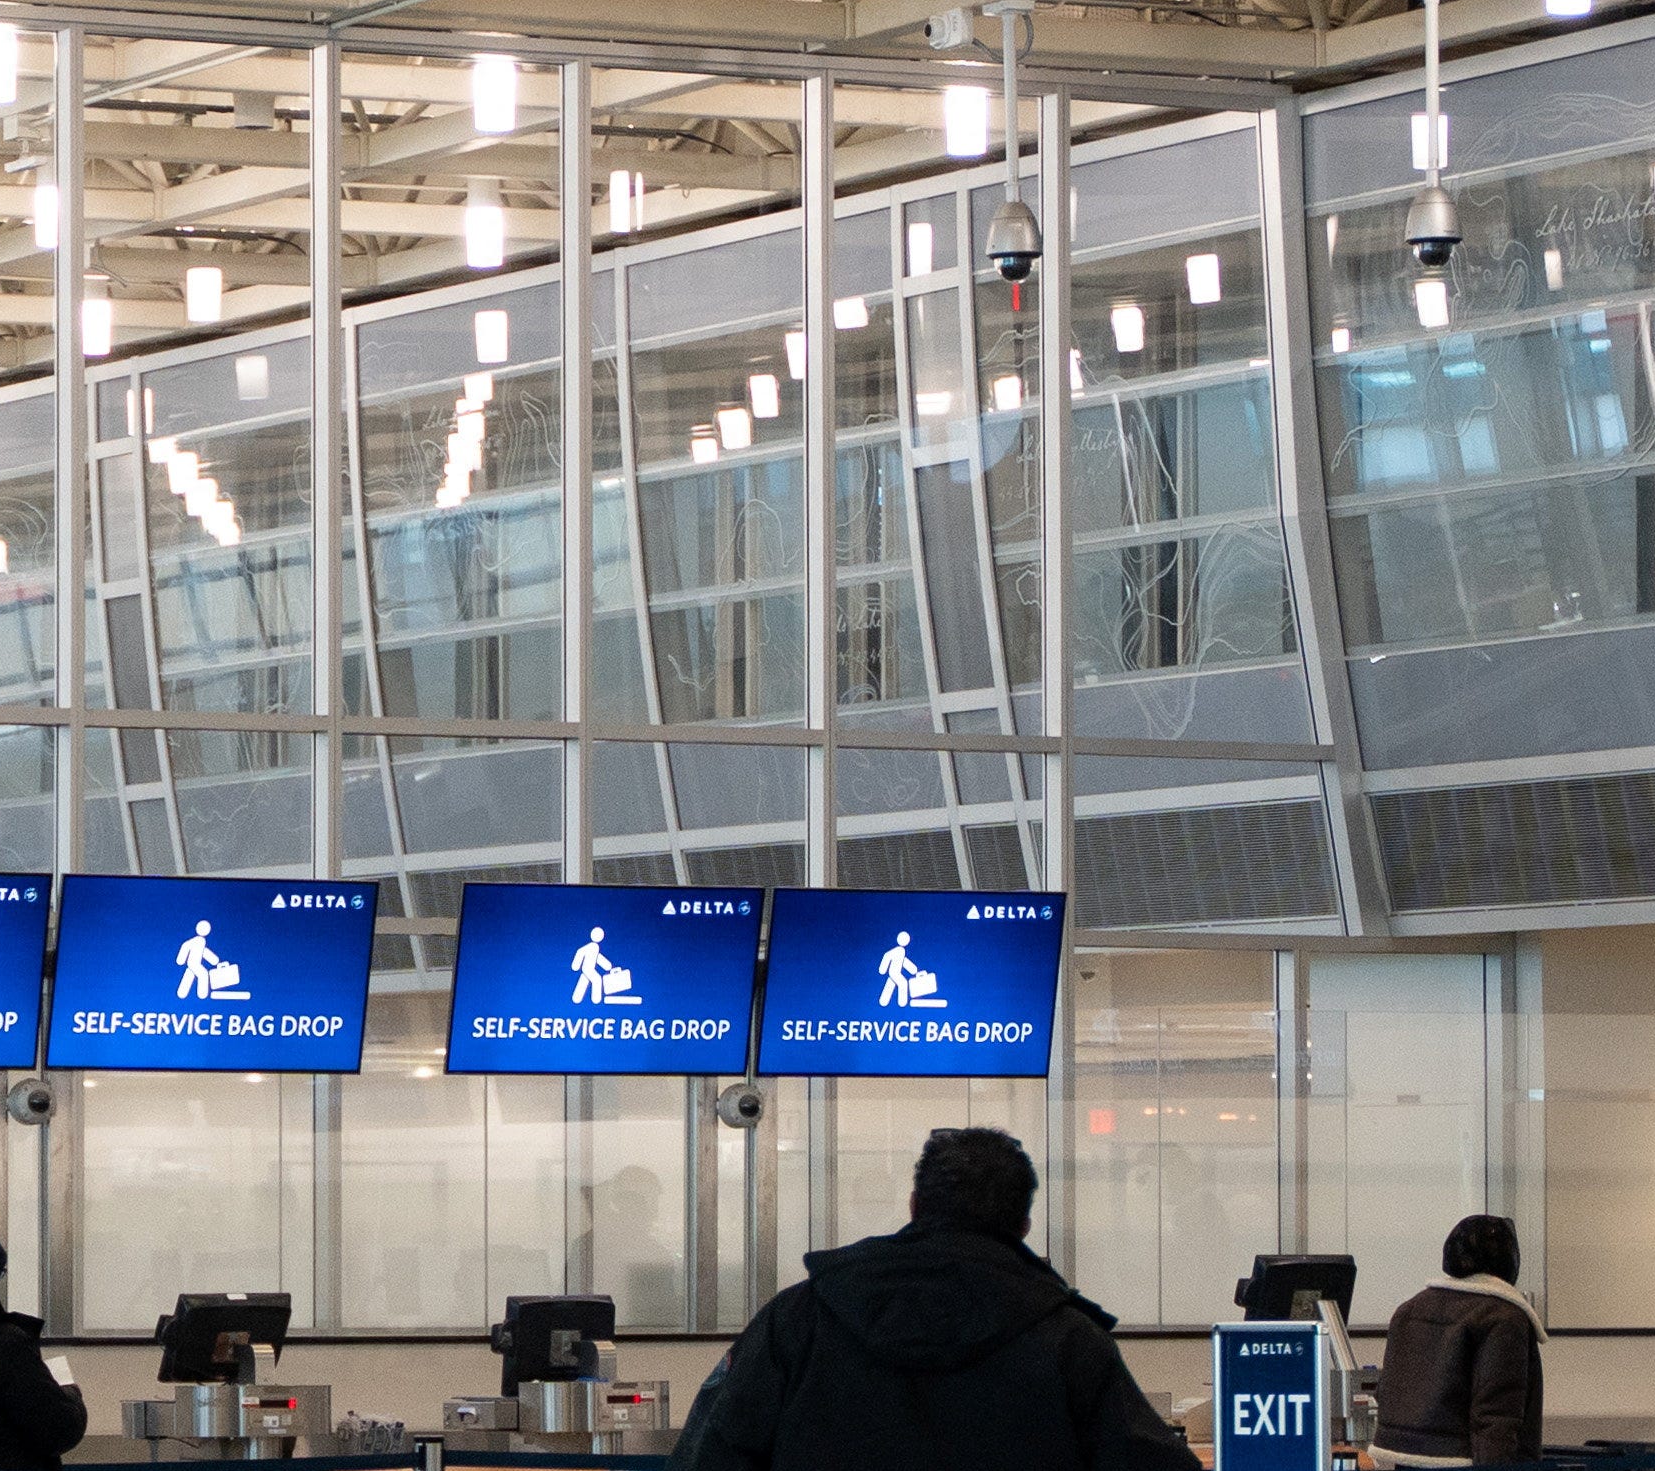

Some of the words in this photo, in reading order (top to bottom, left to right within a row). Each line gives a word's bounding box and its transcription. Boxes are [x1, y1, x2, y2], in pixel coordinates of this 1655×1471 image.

[291, 894, 347, 909] DELTA
[681, 901, 734, 915] DELTA
[984, 906, 1037, 920] DELTA
[73, 1011, 221, 1035] SELF-SERVICE
[228, 1013, 275, 1036] BAG
[280, 1014, 344, 1038] DROP
[472, 1016, 614, 1041] SELF-SERVICE
[621, 1018, 666, 1041] BAG
[670, 1019, 731, 1041] DROP
[781, 1019, 921, 1043] SELF-SERVICE
[925, 1021, 970, 1043] BAG
[974, 1021, 1033, 1044] DROP
[1252, 1343, 1292, 1355] DELTA
[1234, 1394, 1311, 1436] EXIT
